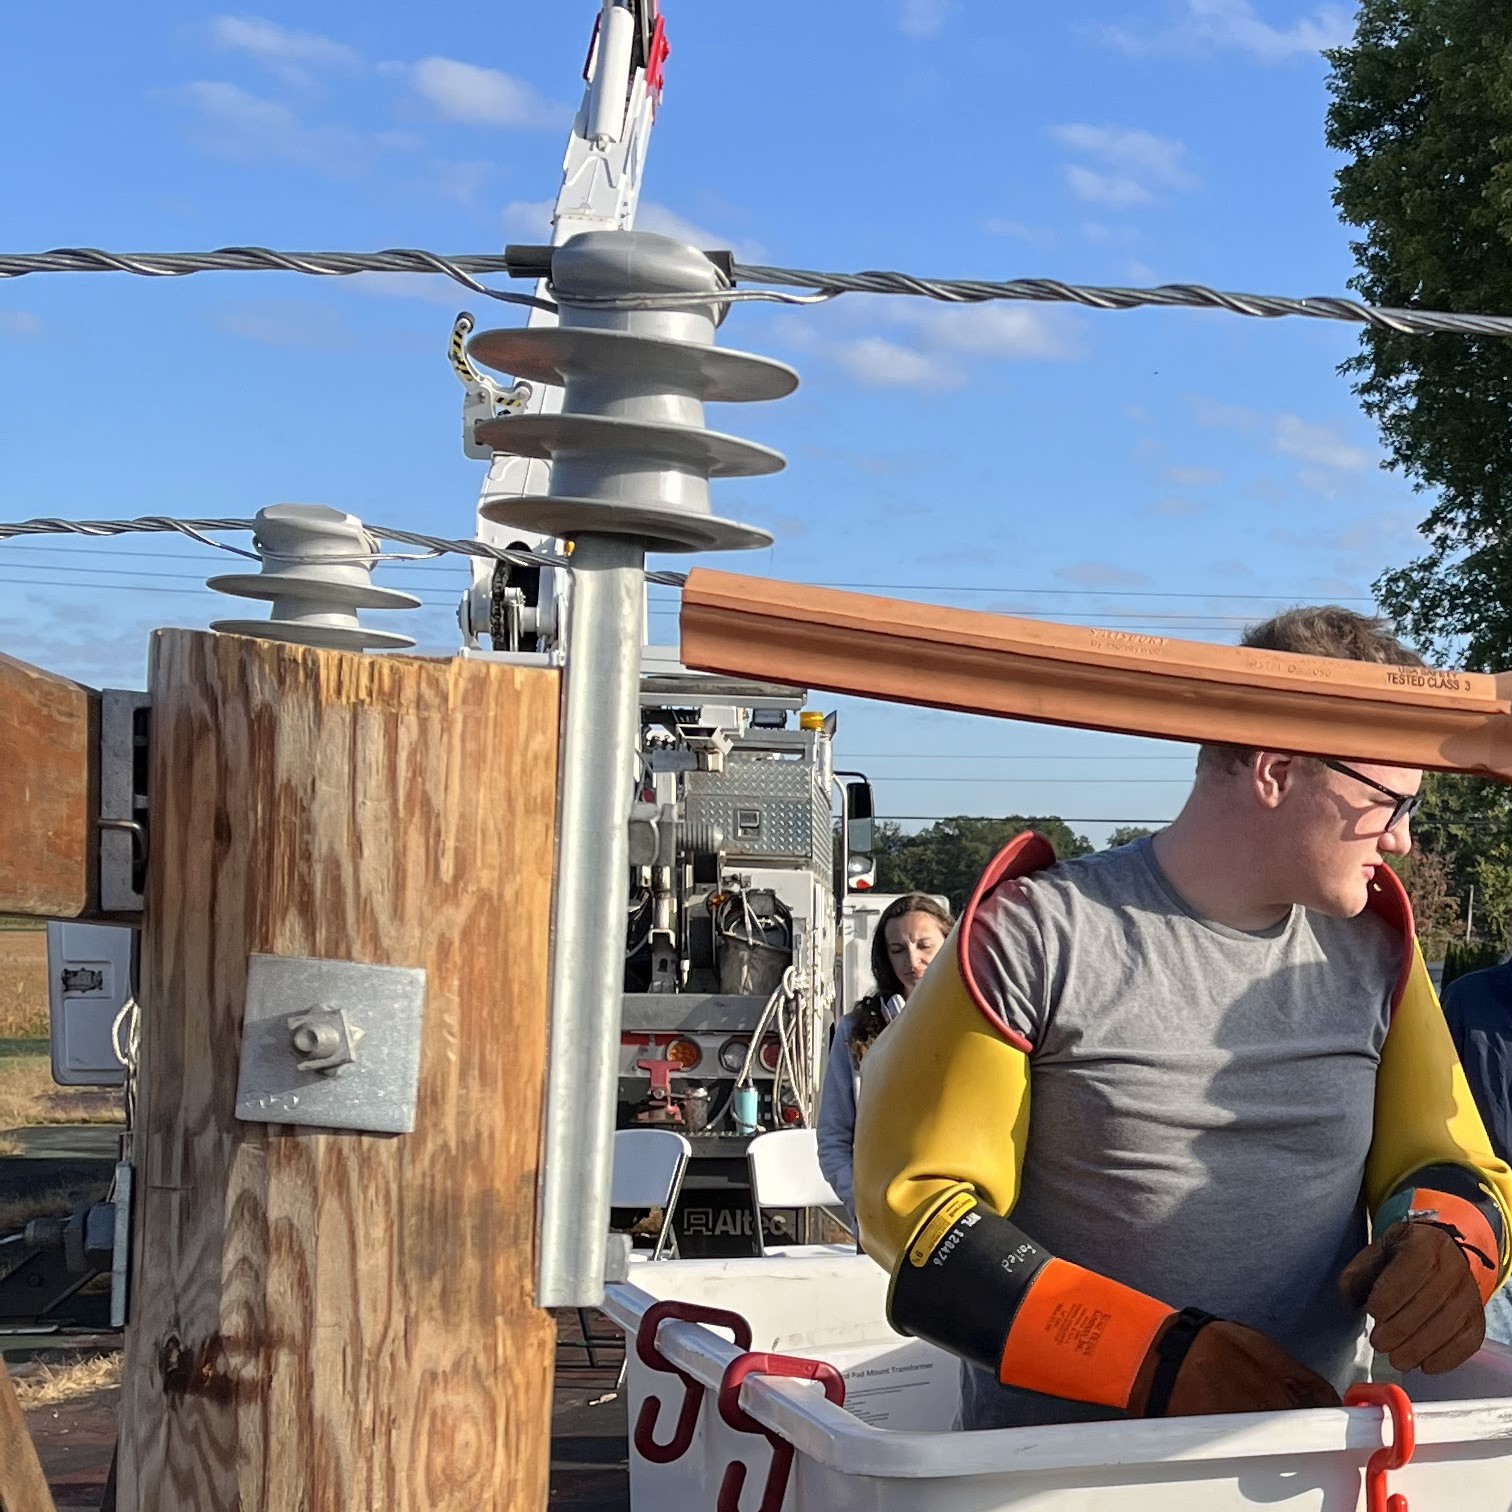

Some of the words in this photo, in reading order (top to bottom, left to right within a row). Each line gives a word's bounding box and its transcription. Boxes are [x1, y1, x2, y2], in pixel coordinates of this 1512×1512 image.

[1386, 672, 1426, 688] TESTED
[1427, 677, 1460, 691] CLASS
[1464, 680, 1471, 692] 3
[866, 1368, 890, 1377] Mount
[891, 1362, 934, 1374] Transformer
